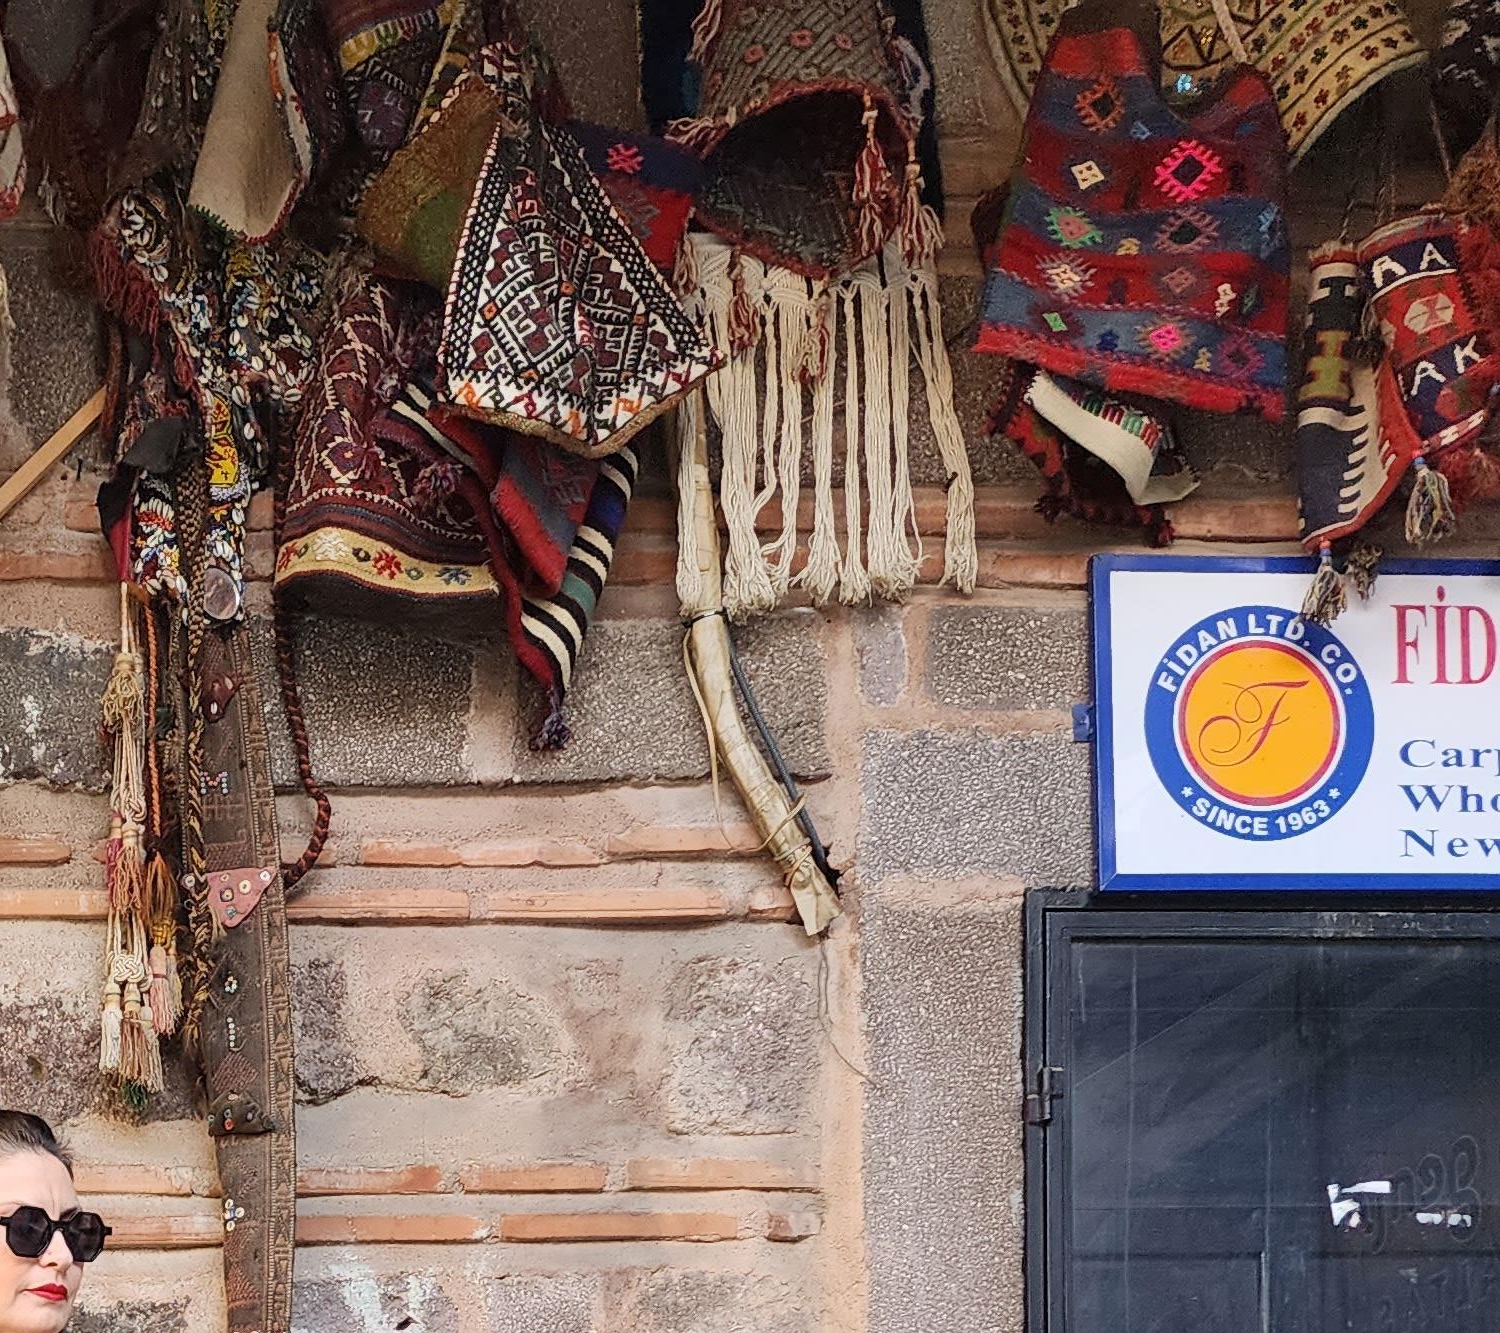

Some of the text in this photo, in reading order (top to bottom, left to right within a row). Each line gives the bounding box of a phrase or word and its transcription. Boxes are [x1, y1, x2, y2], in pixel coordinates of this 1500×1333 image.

[1320, 643, 1358, 695] CO.
[1399, 738, 1500, 776] Car
[1191, 798, 1332, 837] SINCE 1963
